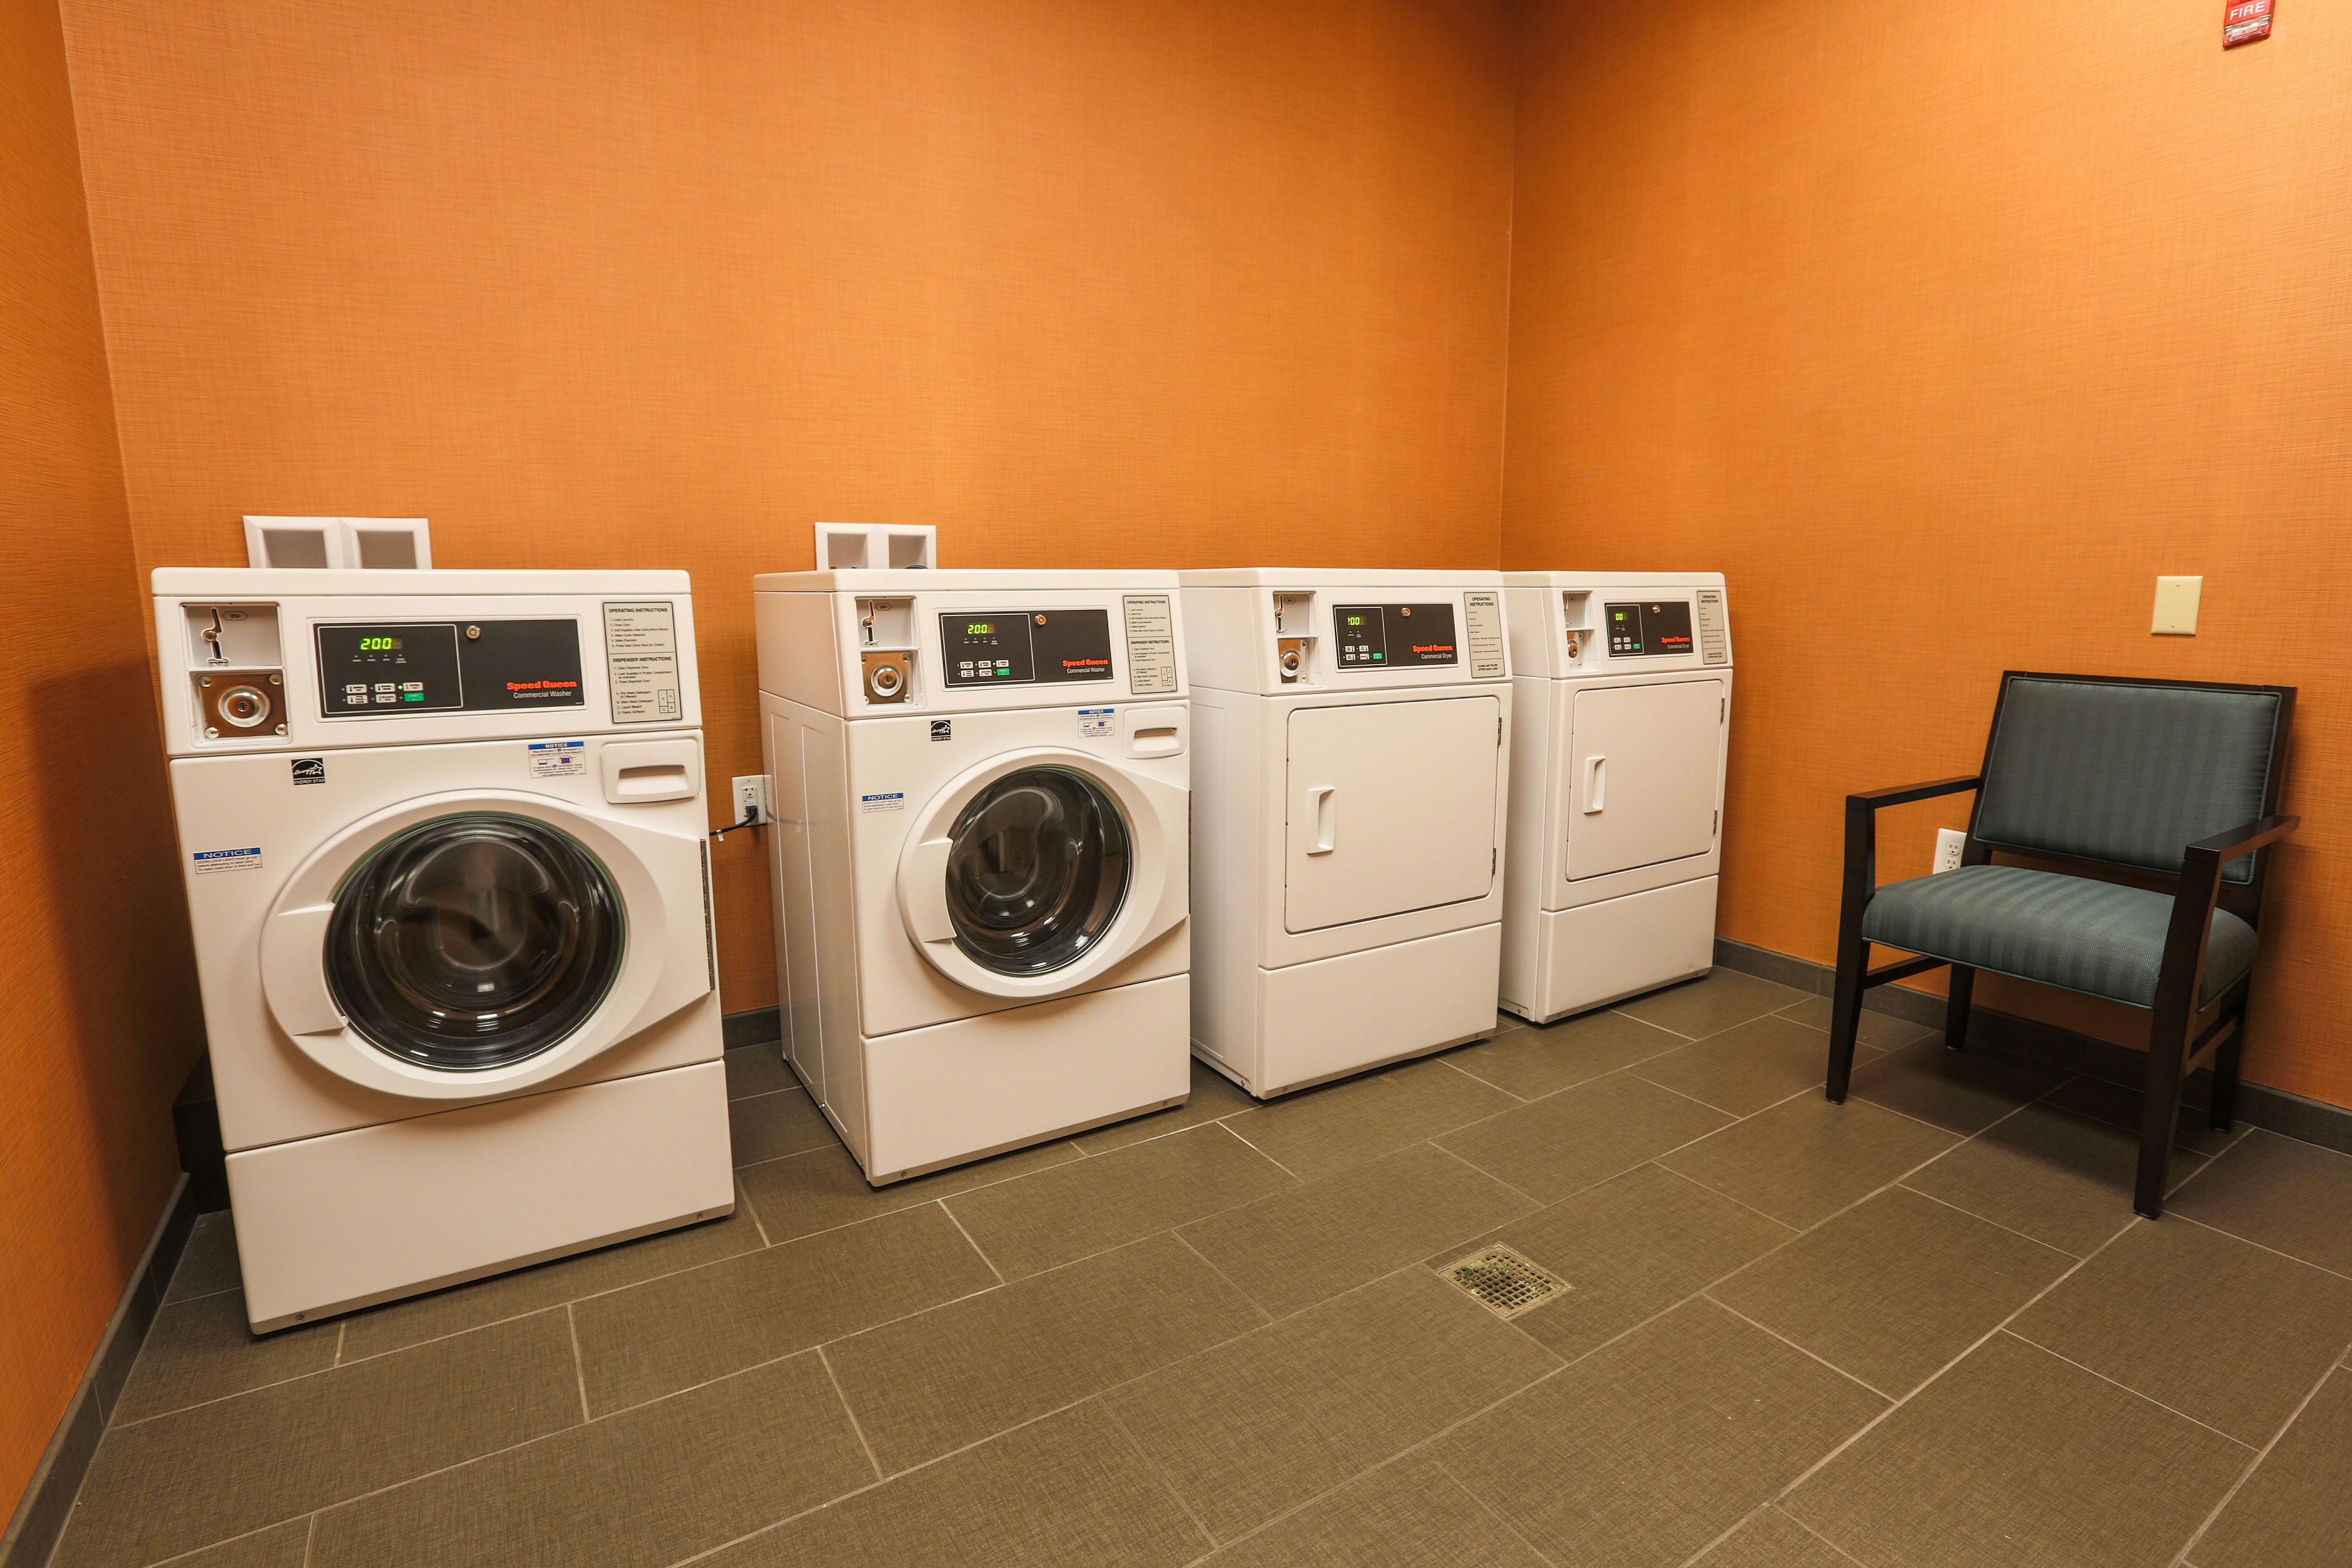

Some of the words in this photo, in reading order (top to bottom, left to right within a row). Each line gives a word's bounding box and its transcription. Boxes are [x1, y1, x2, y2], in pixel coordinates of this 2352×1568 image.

[2230, 1, 2265, 20] FIRE
[968, 624, 987, 634] 200
[360, 638, 392, 650] 200
[1413, 645, 1432, 653] Speed
[507, 681, 541, 691] Speed
[203, 849, 252, 858] NOTICE
